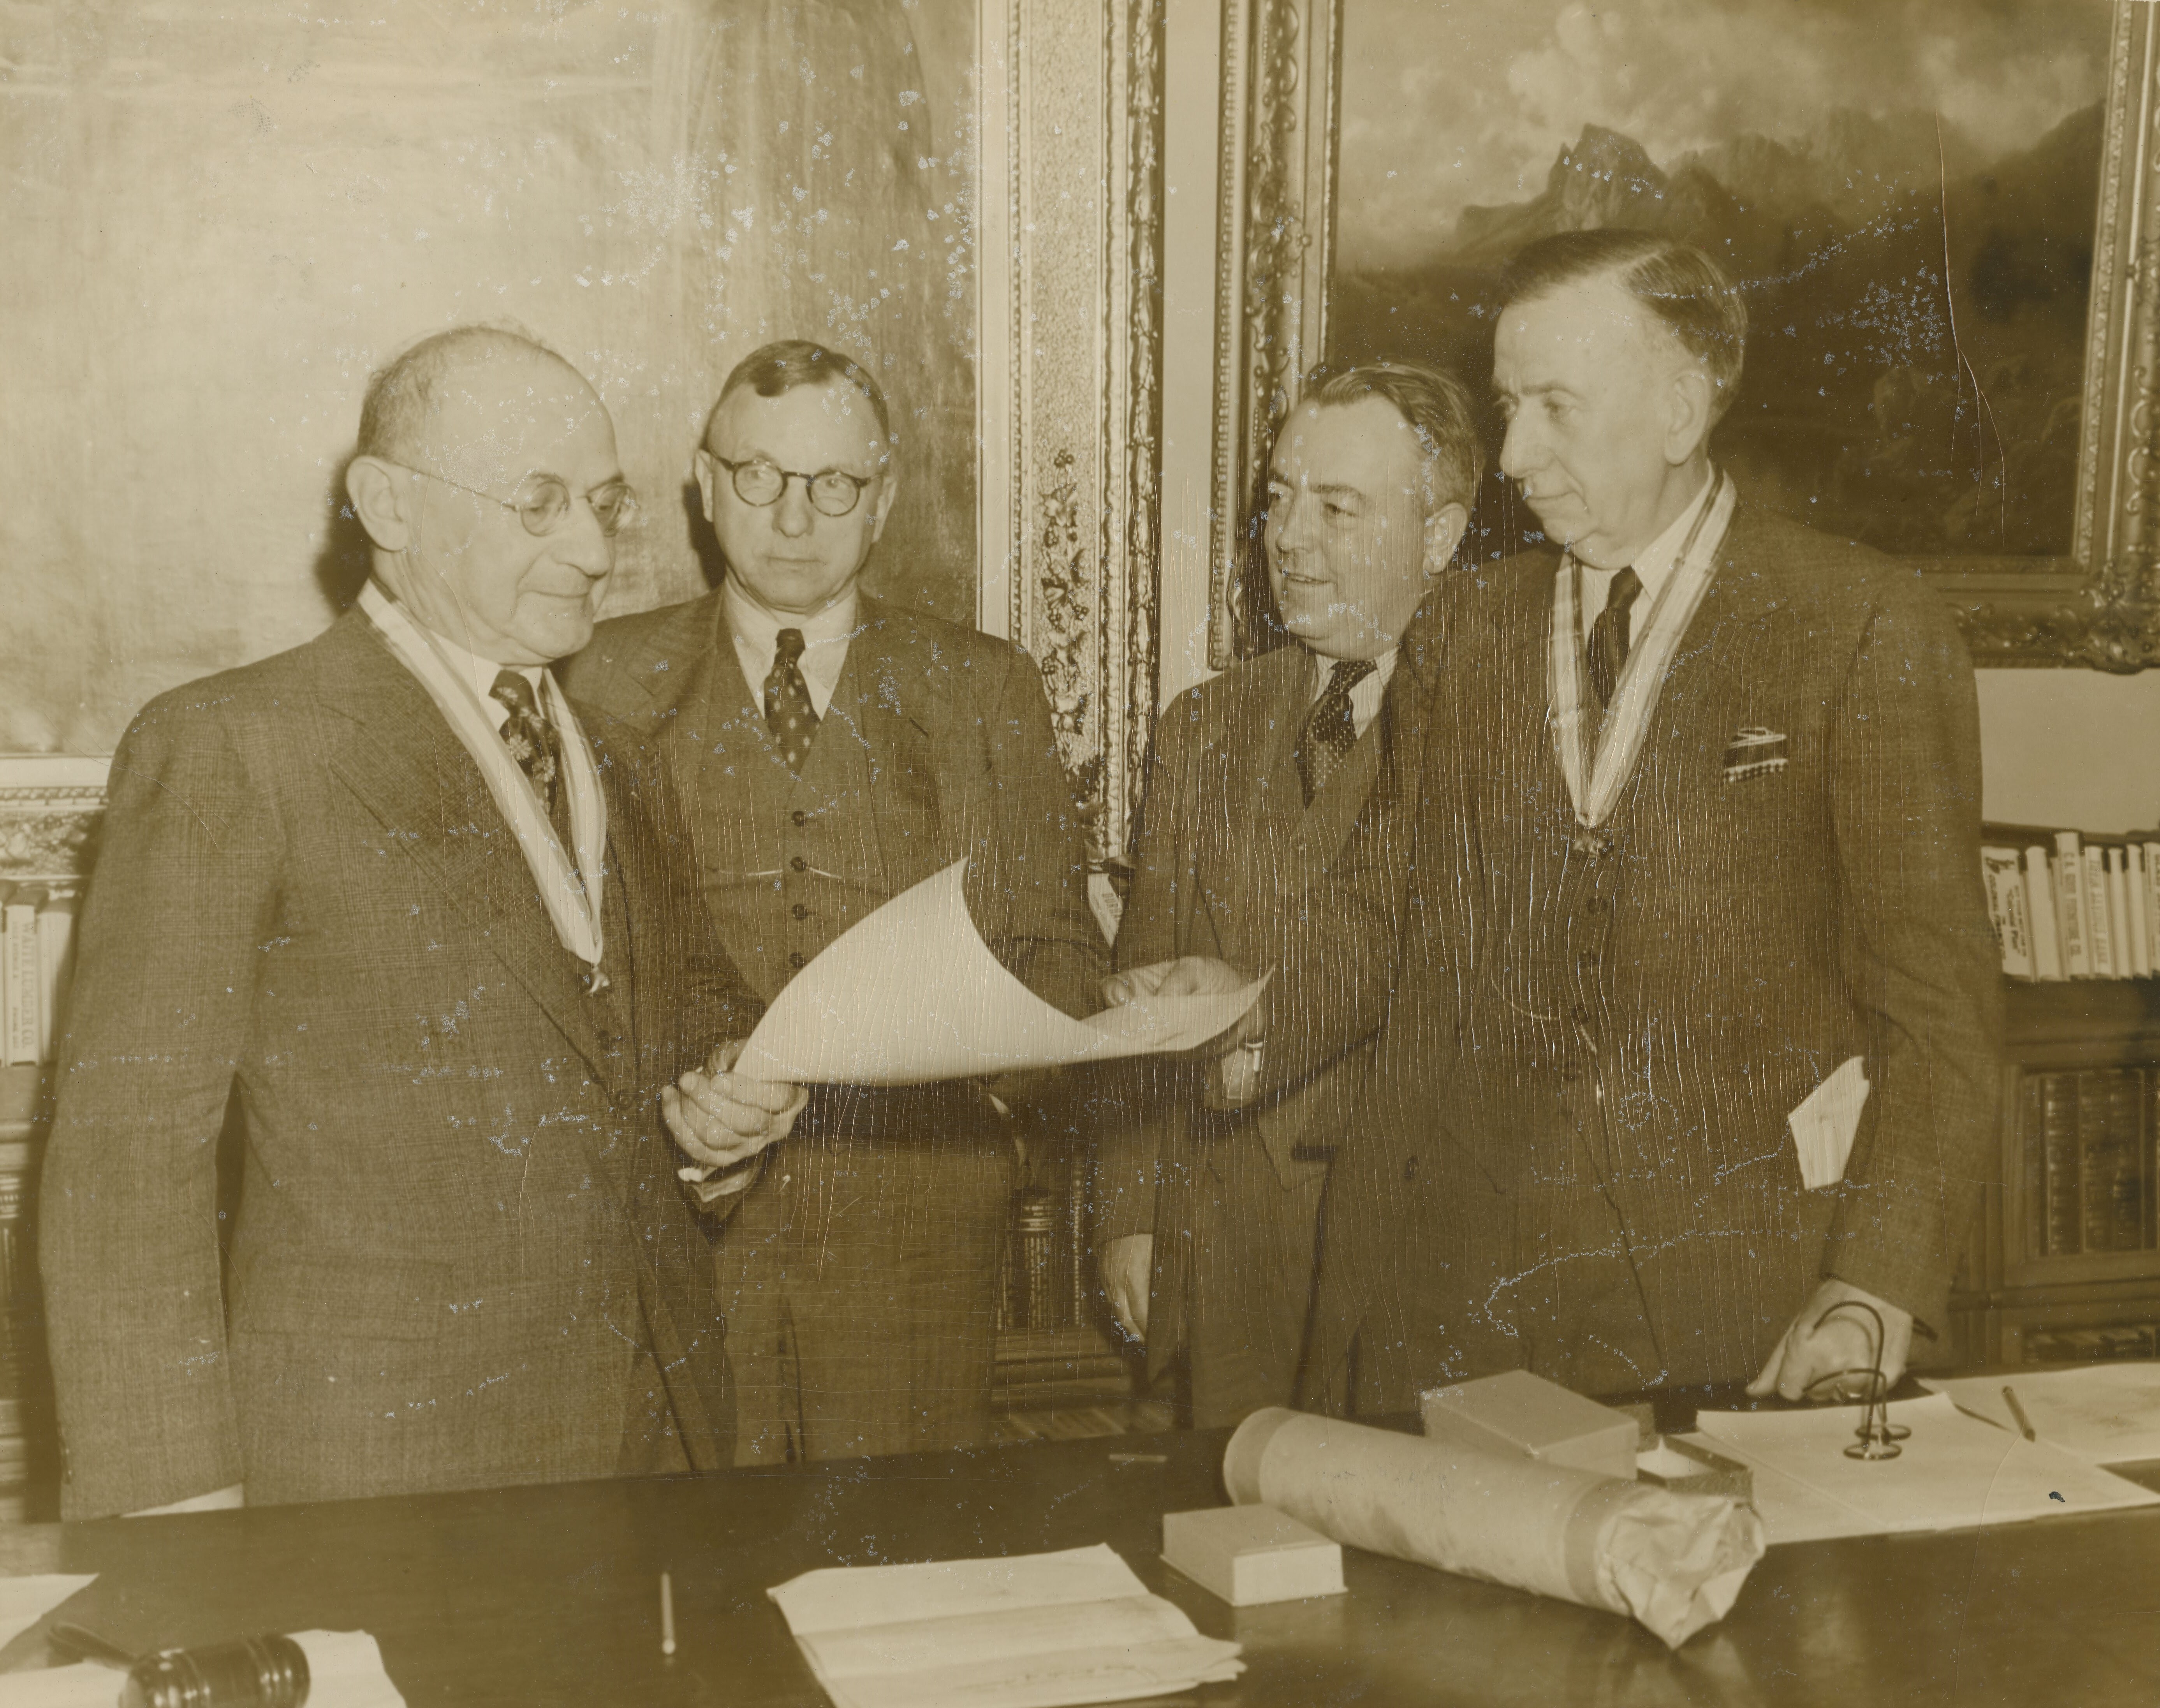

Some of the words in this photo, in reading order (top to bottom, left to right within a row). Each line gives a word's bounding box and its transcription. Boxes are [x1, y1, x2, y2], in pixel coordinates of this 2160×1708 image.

[21, 922, 35, 967] WAITE
[21, 970, 34, 1025] LUMBER
[21, 1029, 34, 1048] CO.
